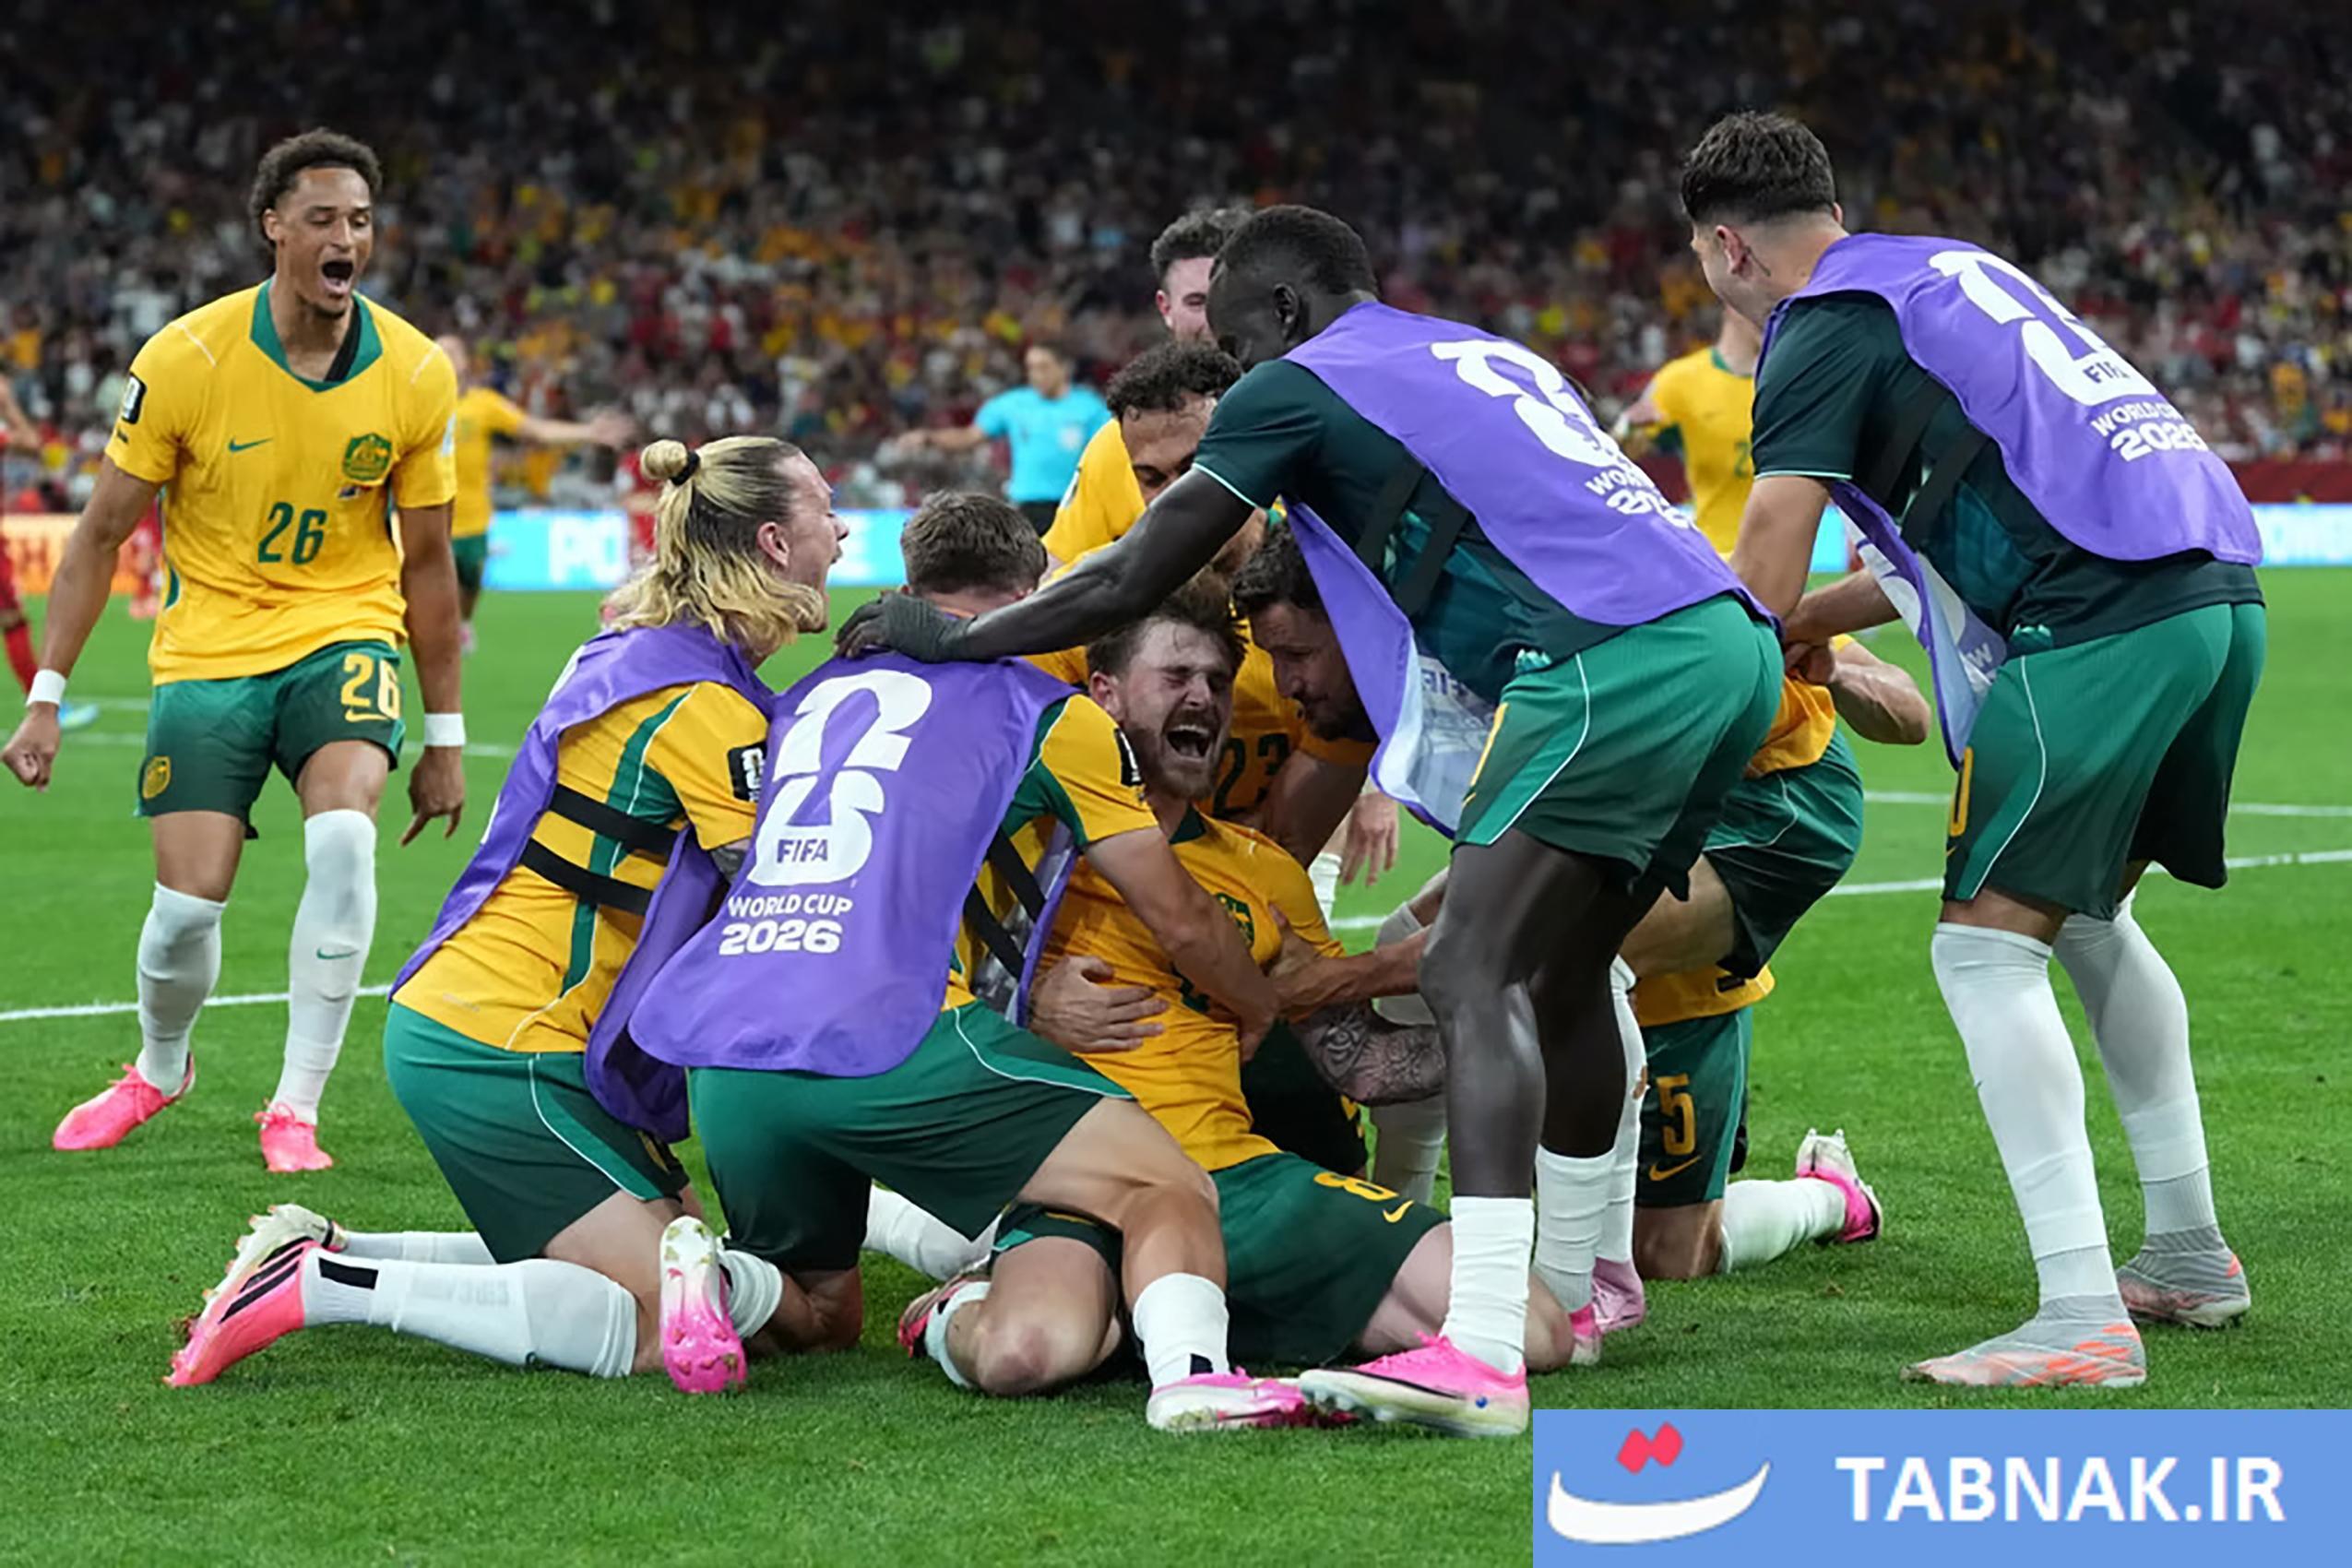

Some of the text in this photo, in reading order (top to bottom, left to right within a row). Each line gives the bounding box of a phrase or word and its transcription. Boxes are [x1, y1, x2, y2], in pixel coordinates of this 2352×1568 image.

[2110, 422, 2209, 462] 2026
[258, 502, 327, 564] 26
[340, 653, 400, 720] 26
[777, 838, 828, 863] FIFA
[728, 894, 853, 917] WORLD CUP
[719, 919, 843, 956] 2026
[1657, 1073, 1697, 1156] 5
